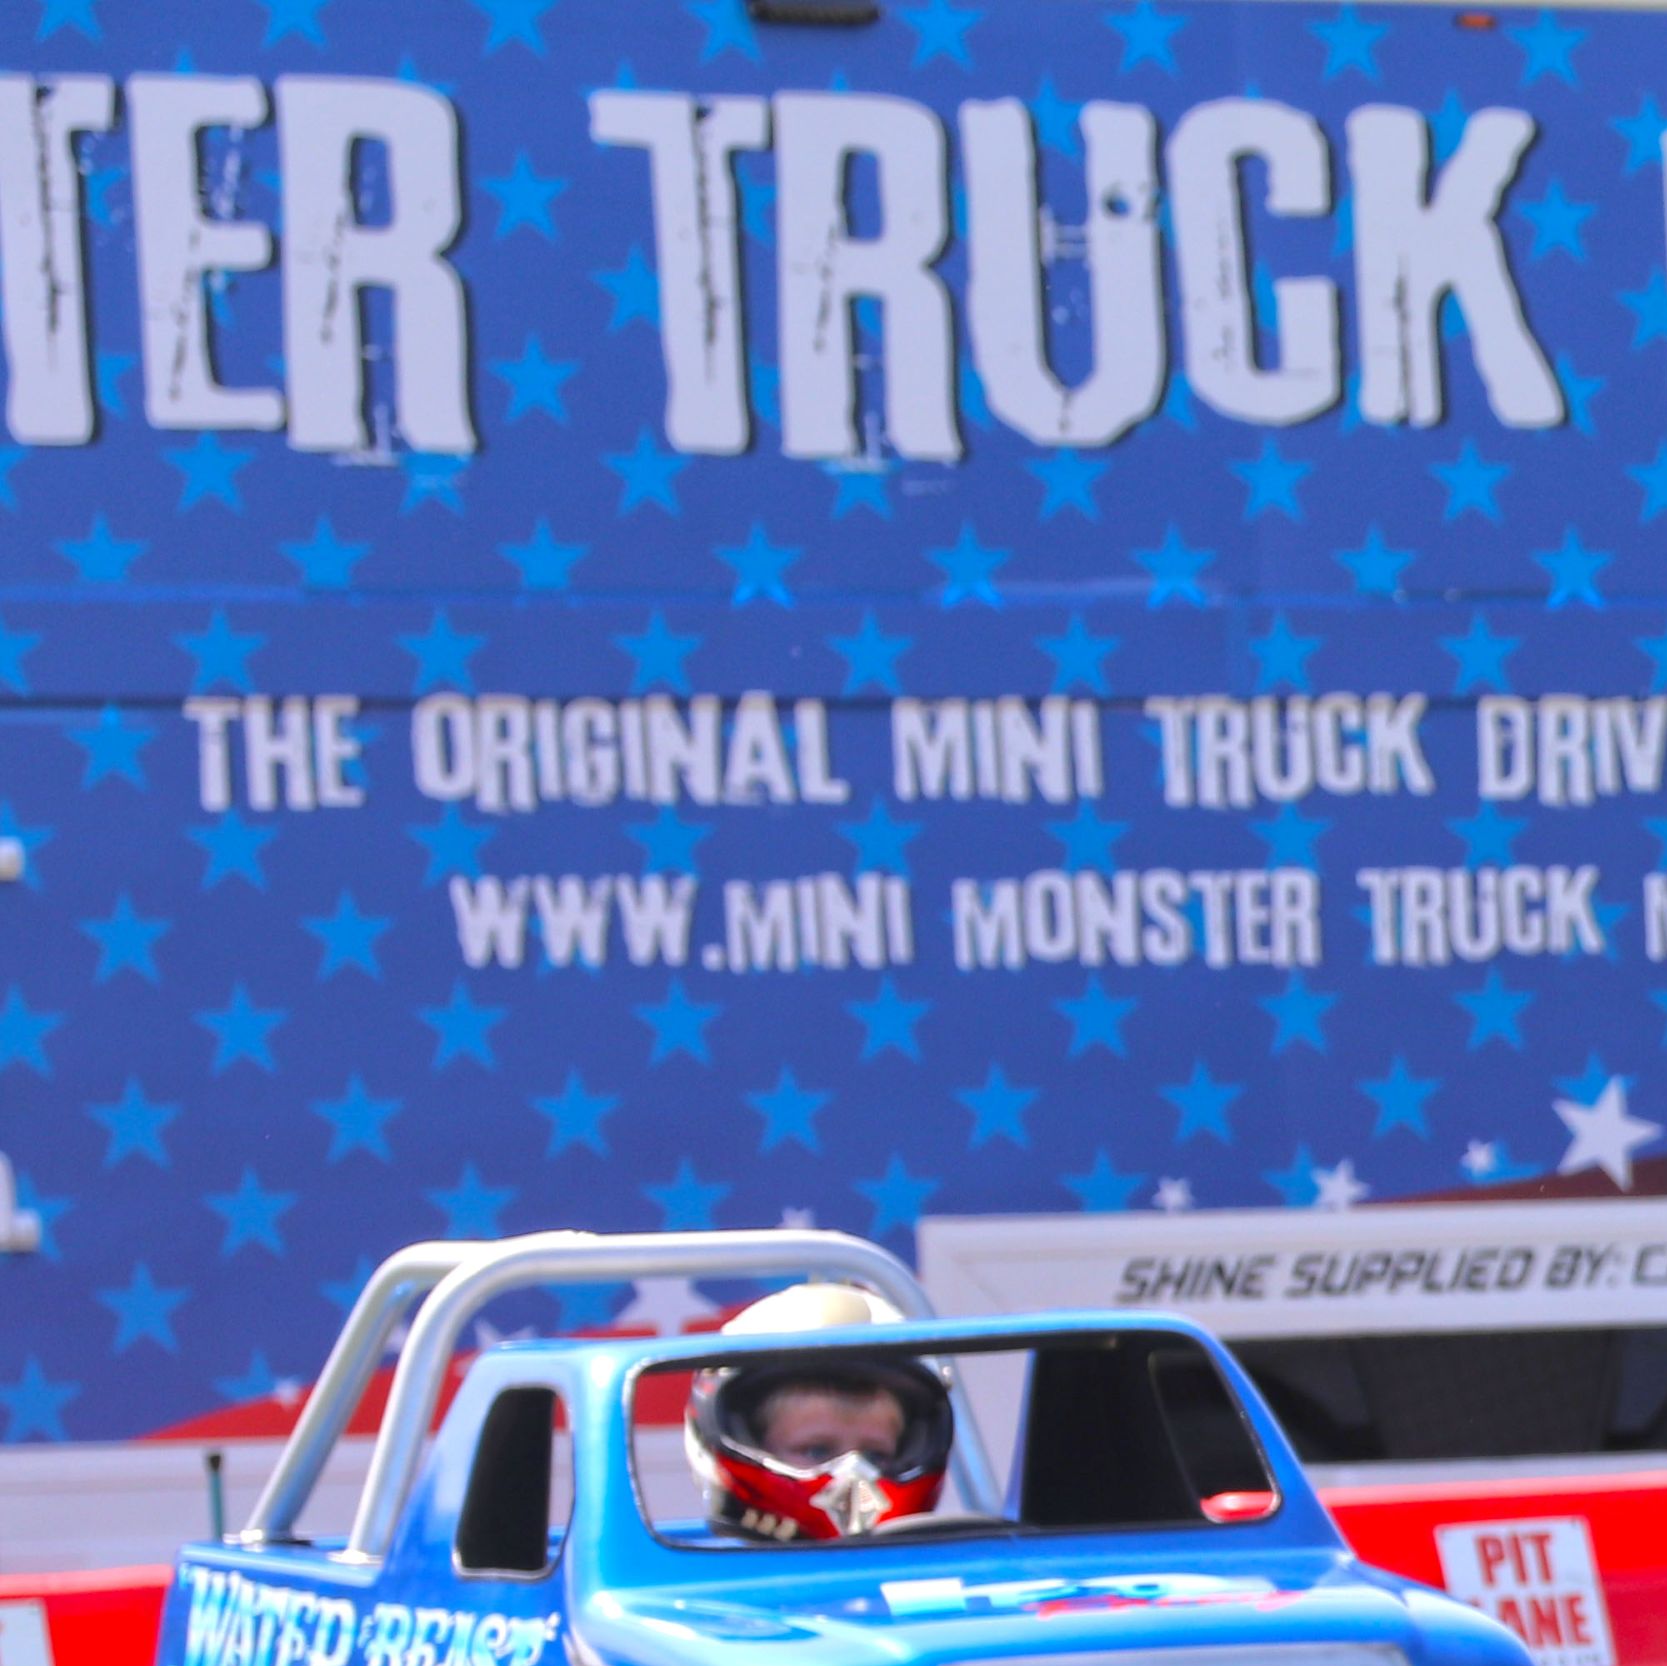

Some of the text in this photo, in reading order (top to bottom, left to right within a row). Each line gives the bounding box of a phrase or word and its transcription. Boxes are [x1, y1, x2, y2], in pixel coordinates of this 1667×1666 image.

[590, 91, 1567, 466] TRUCK
[186, 692, 365, 812] THE
[411, 690, 849, 812] ORIGINAL
[891, 695, 1104, 802] MINI
[1146, 692, 1434, 806] TRUCK
[450, 870, 913, 970] WWW.MINI
[952, 866, 1321, 968] MONSTER
[1356, 865, 1603, 965] TRUCK
[1115, 1254, 1276, 1304] SHINE
[1283, 1246, 1536, 1298] SUPPLIED
[1546, 1244, 1626, 1291] BY:
[1475, 1531, 1554, 1587] PIT
[1467, 1593, 1593, 1647] ANE
